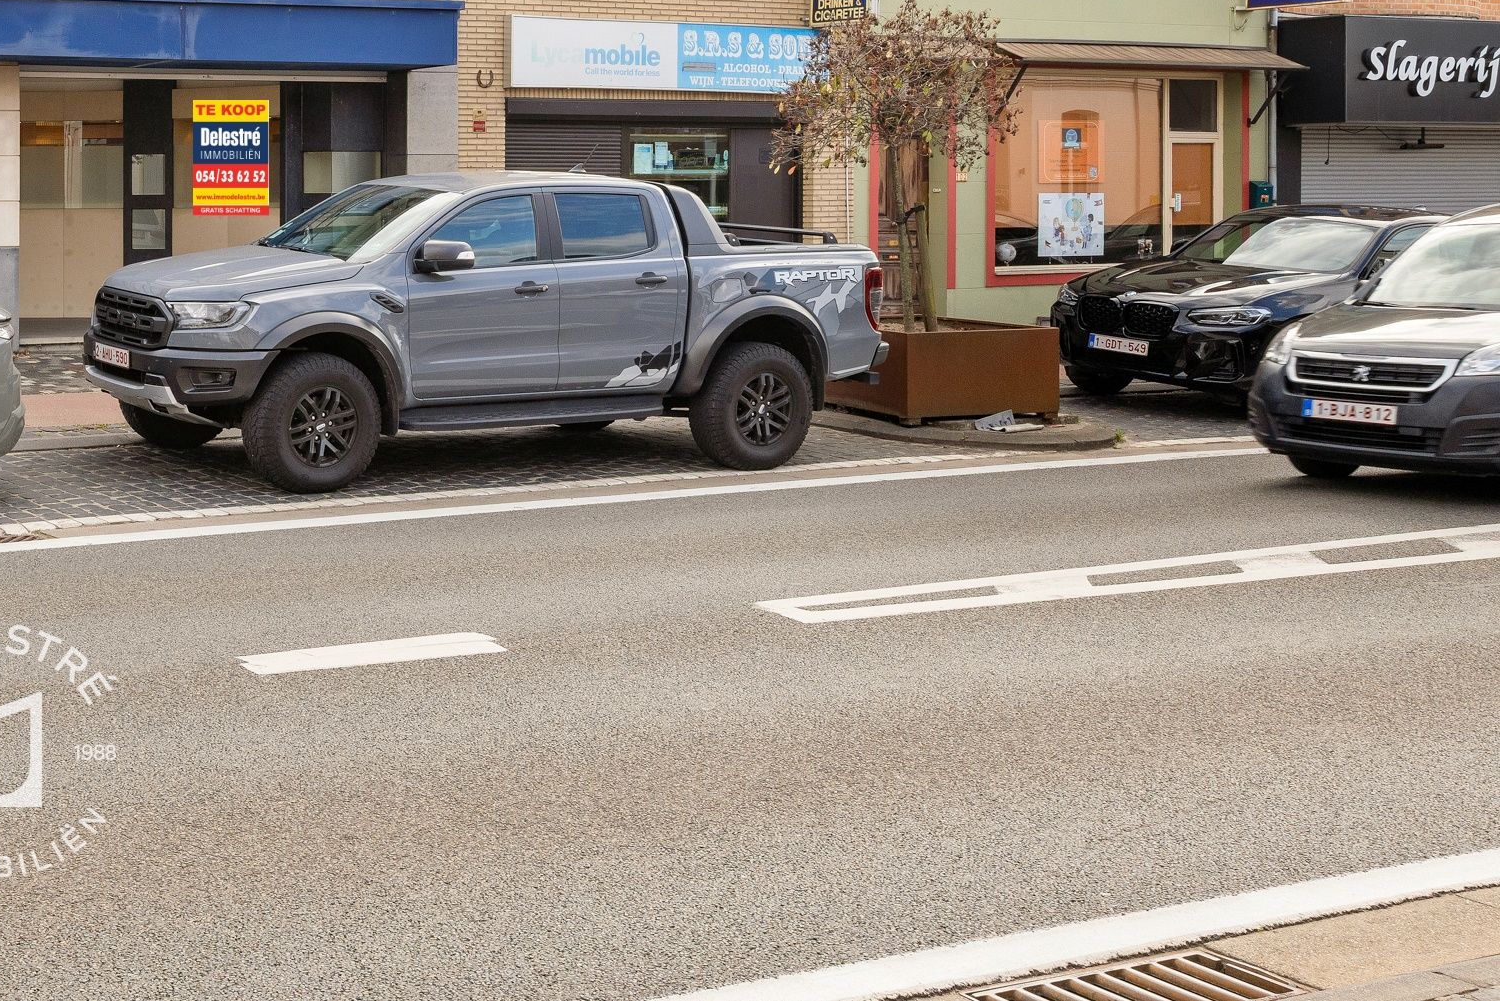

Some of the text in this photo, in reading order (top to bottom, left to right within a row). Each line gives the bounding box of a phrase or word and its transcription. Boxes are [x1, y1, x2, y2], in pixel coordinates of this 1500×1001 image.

[747, 32, 764, 59] &
[585, 67, 660, 77] Call the world for less
[723, 63, 771, 74] ALCOHOL
[1365, 39, 1500, 98] Slagerij
[689, 75, 714, 88] WIJN
[195, 105, 266, 116] TE KOOP
[200, 127, 260, 147] Delestré
[200, 149, 261, 160] IMMOBILIËN
[195, 169, 266, 183] 054/33 62 52
[774, 268, 858, 288] RAPTOR
[1096, 337, 1146, 353] 1-GDT-549
[95, 345, 128, 365] 2-AHU-590
[1318, 402, 1392, 421] 1-BJA-812
